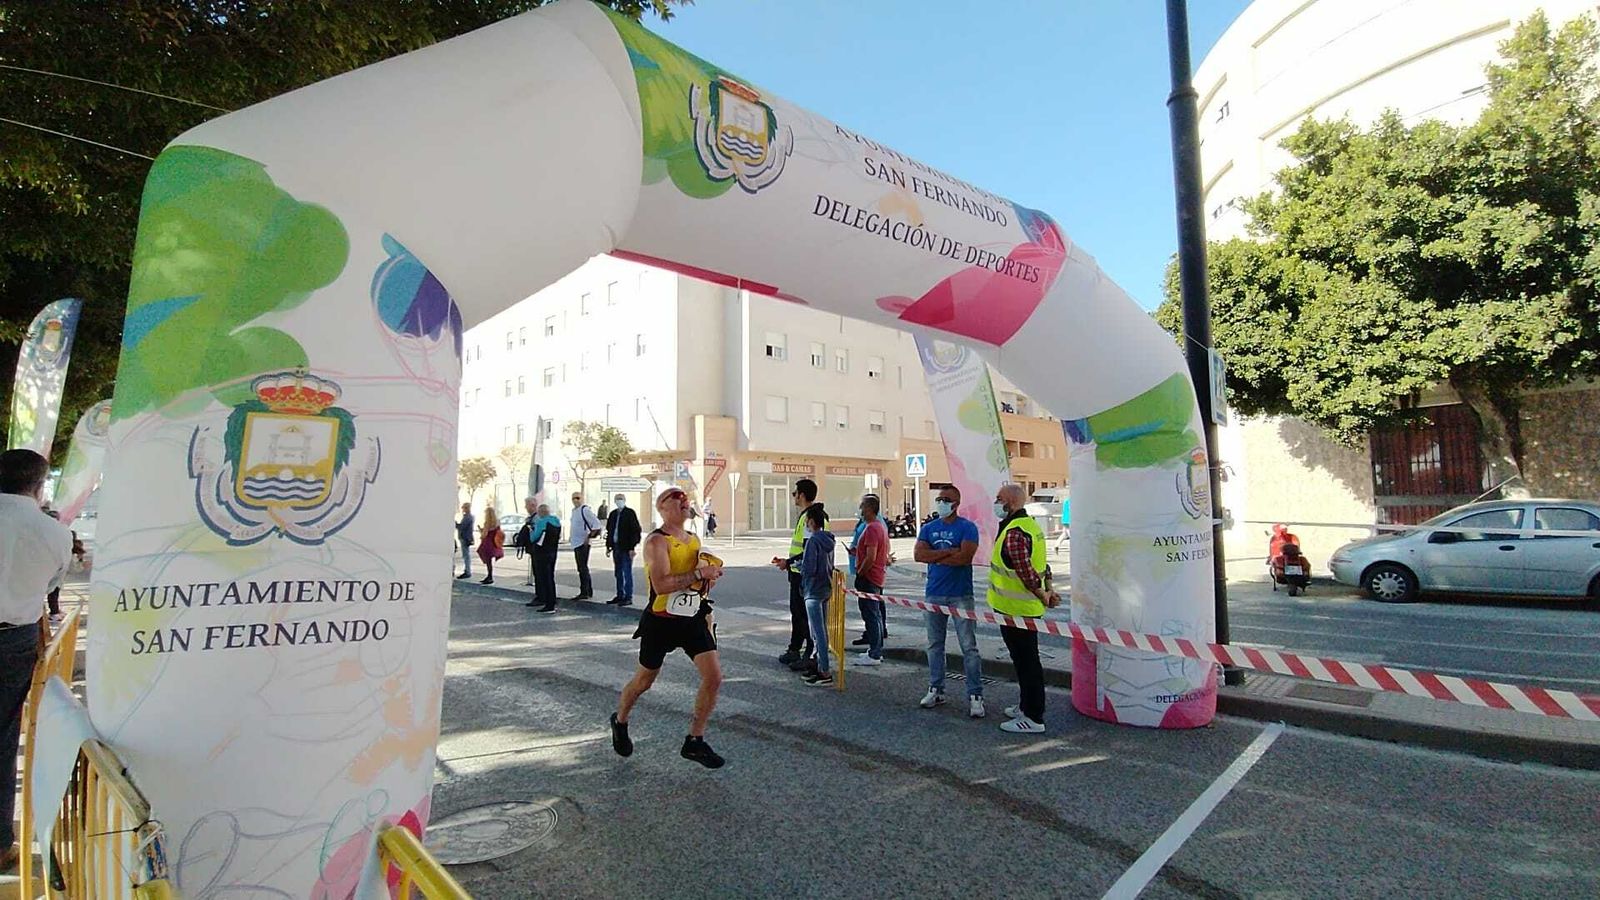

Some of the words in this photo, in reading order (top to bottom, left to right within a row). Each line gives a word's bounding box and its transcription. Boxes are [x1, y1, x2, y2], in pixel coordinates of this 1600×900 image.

[864, 157, 906, 189] SAN
[911, 176, 1008, 228] FERNANDO
[812, 195, 938, 252] DELEGACIÓN
[938, 237, 963, 260] DE
[964, 246, 1041, 284] DEPORTES
[1166, 552, 1189, 563] SAN
[113, 580, 381, 613] AYUNTAMIENTO
[388, 581, 415, 602] DE
[131, 627, 193, 655] SAN
[202, 618, 390, 652] FERNANDO
